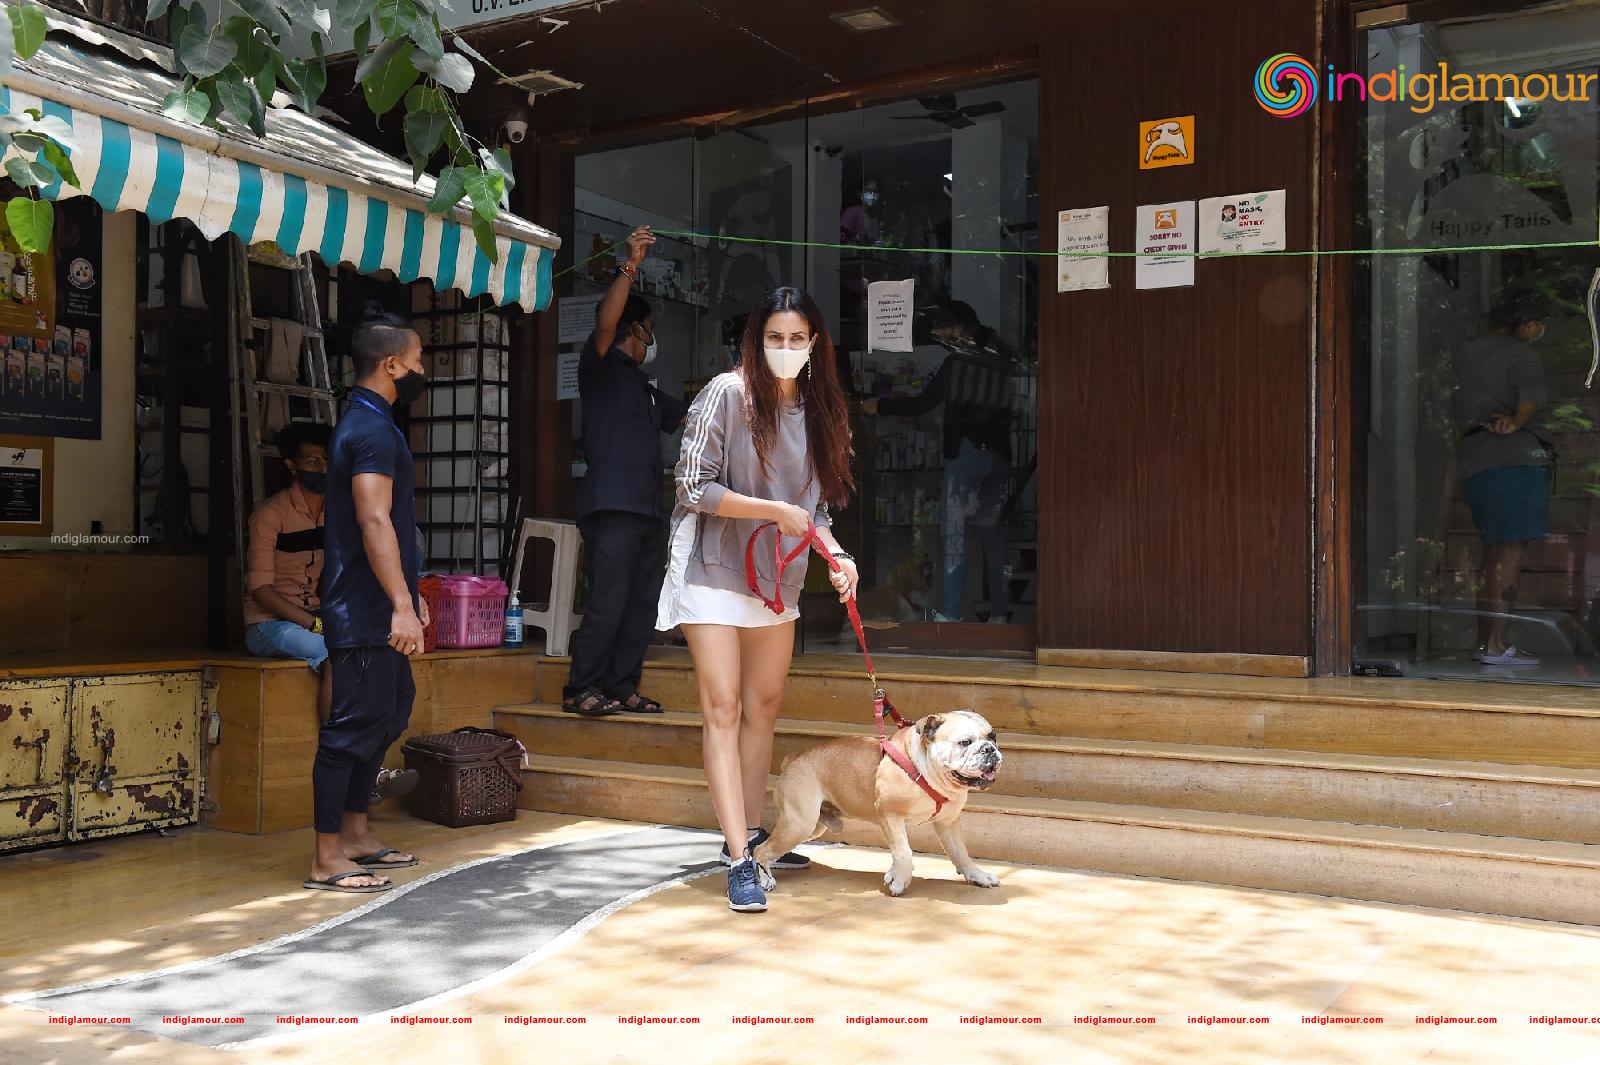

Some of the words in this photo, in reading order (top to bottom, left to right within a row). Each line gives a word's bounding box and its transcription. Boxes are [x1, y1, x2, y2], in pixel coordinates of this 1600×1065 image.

[1238, 206, 1263, 214] MASK,
[1430, 218, 1496, 238] Happy
[1501, 211, 1551, 230] Tails
[1149, 232, 1171, 241] SORRY
[1143, 245, 1167, 253] CREDIT
